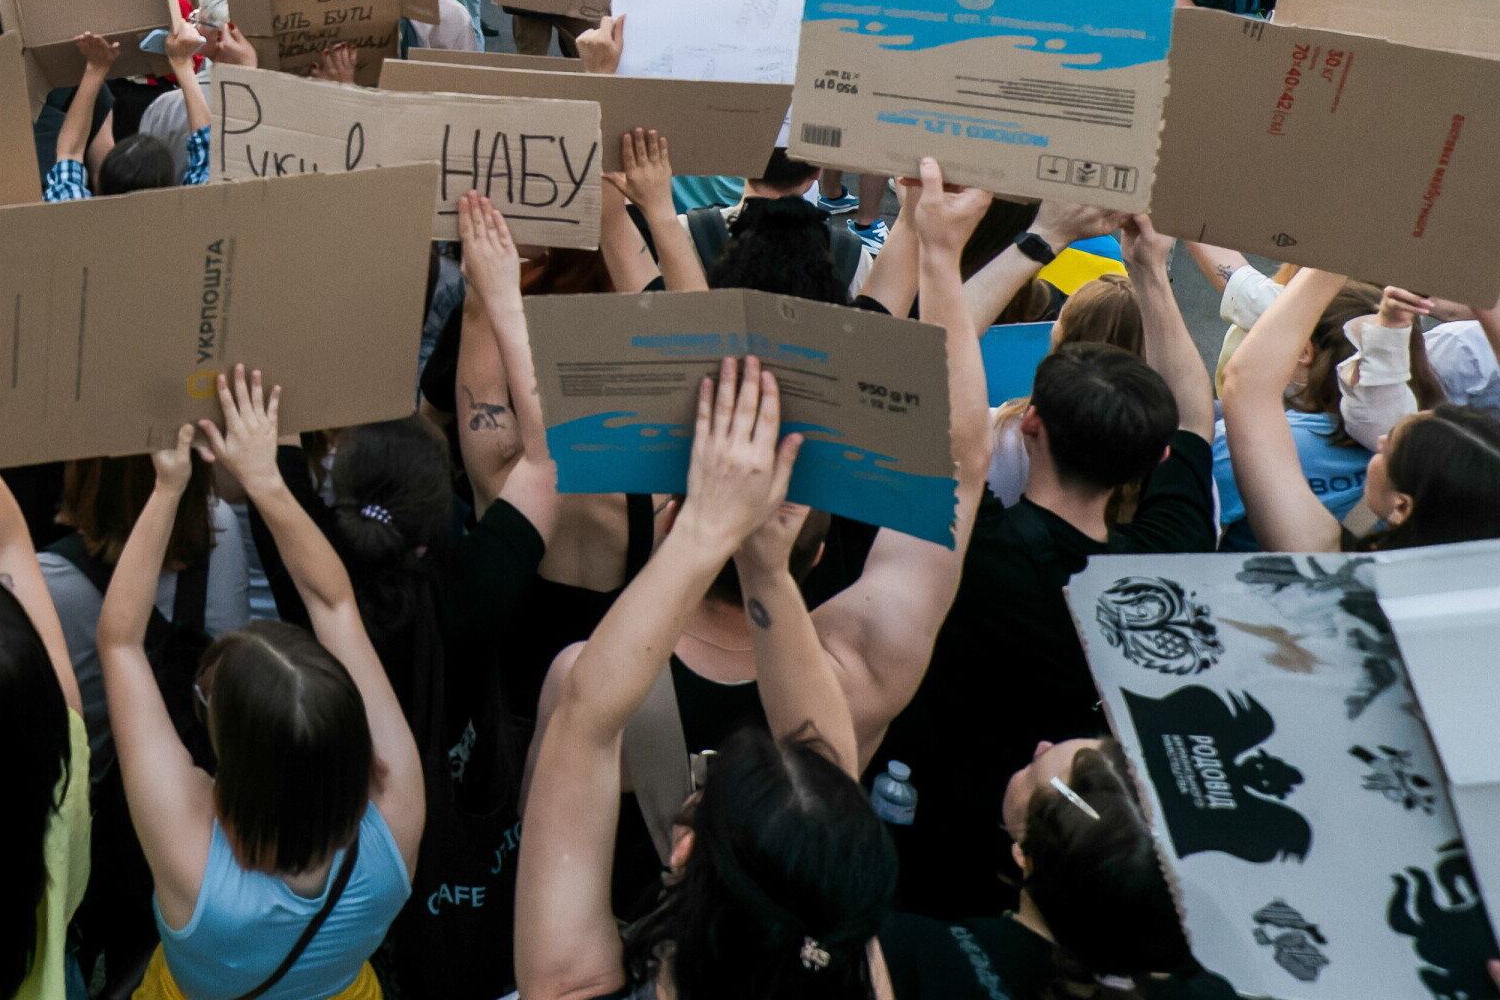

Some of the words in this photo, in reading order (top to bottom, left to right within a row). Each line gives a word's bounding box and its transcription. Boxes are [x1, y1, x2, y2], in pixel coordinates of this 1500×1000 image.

[324, 6, 373, 26] БУТИ
[441, 123, 598, 209] НАБУ
[196, 237, 226, 365] УКРПОШТА
[1188, 734, 1238, 810] РОДОВІД
[427, 883, 487, 915] CAFE
